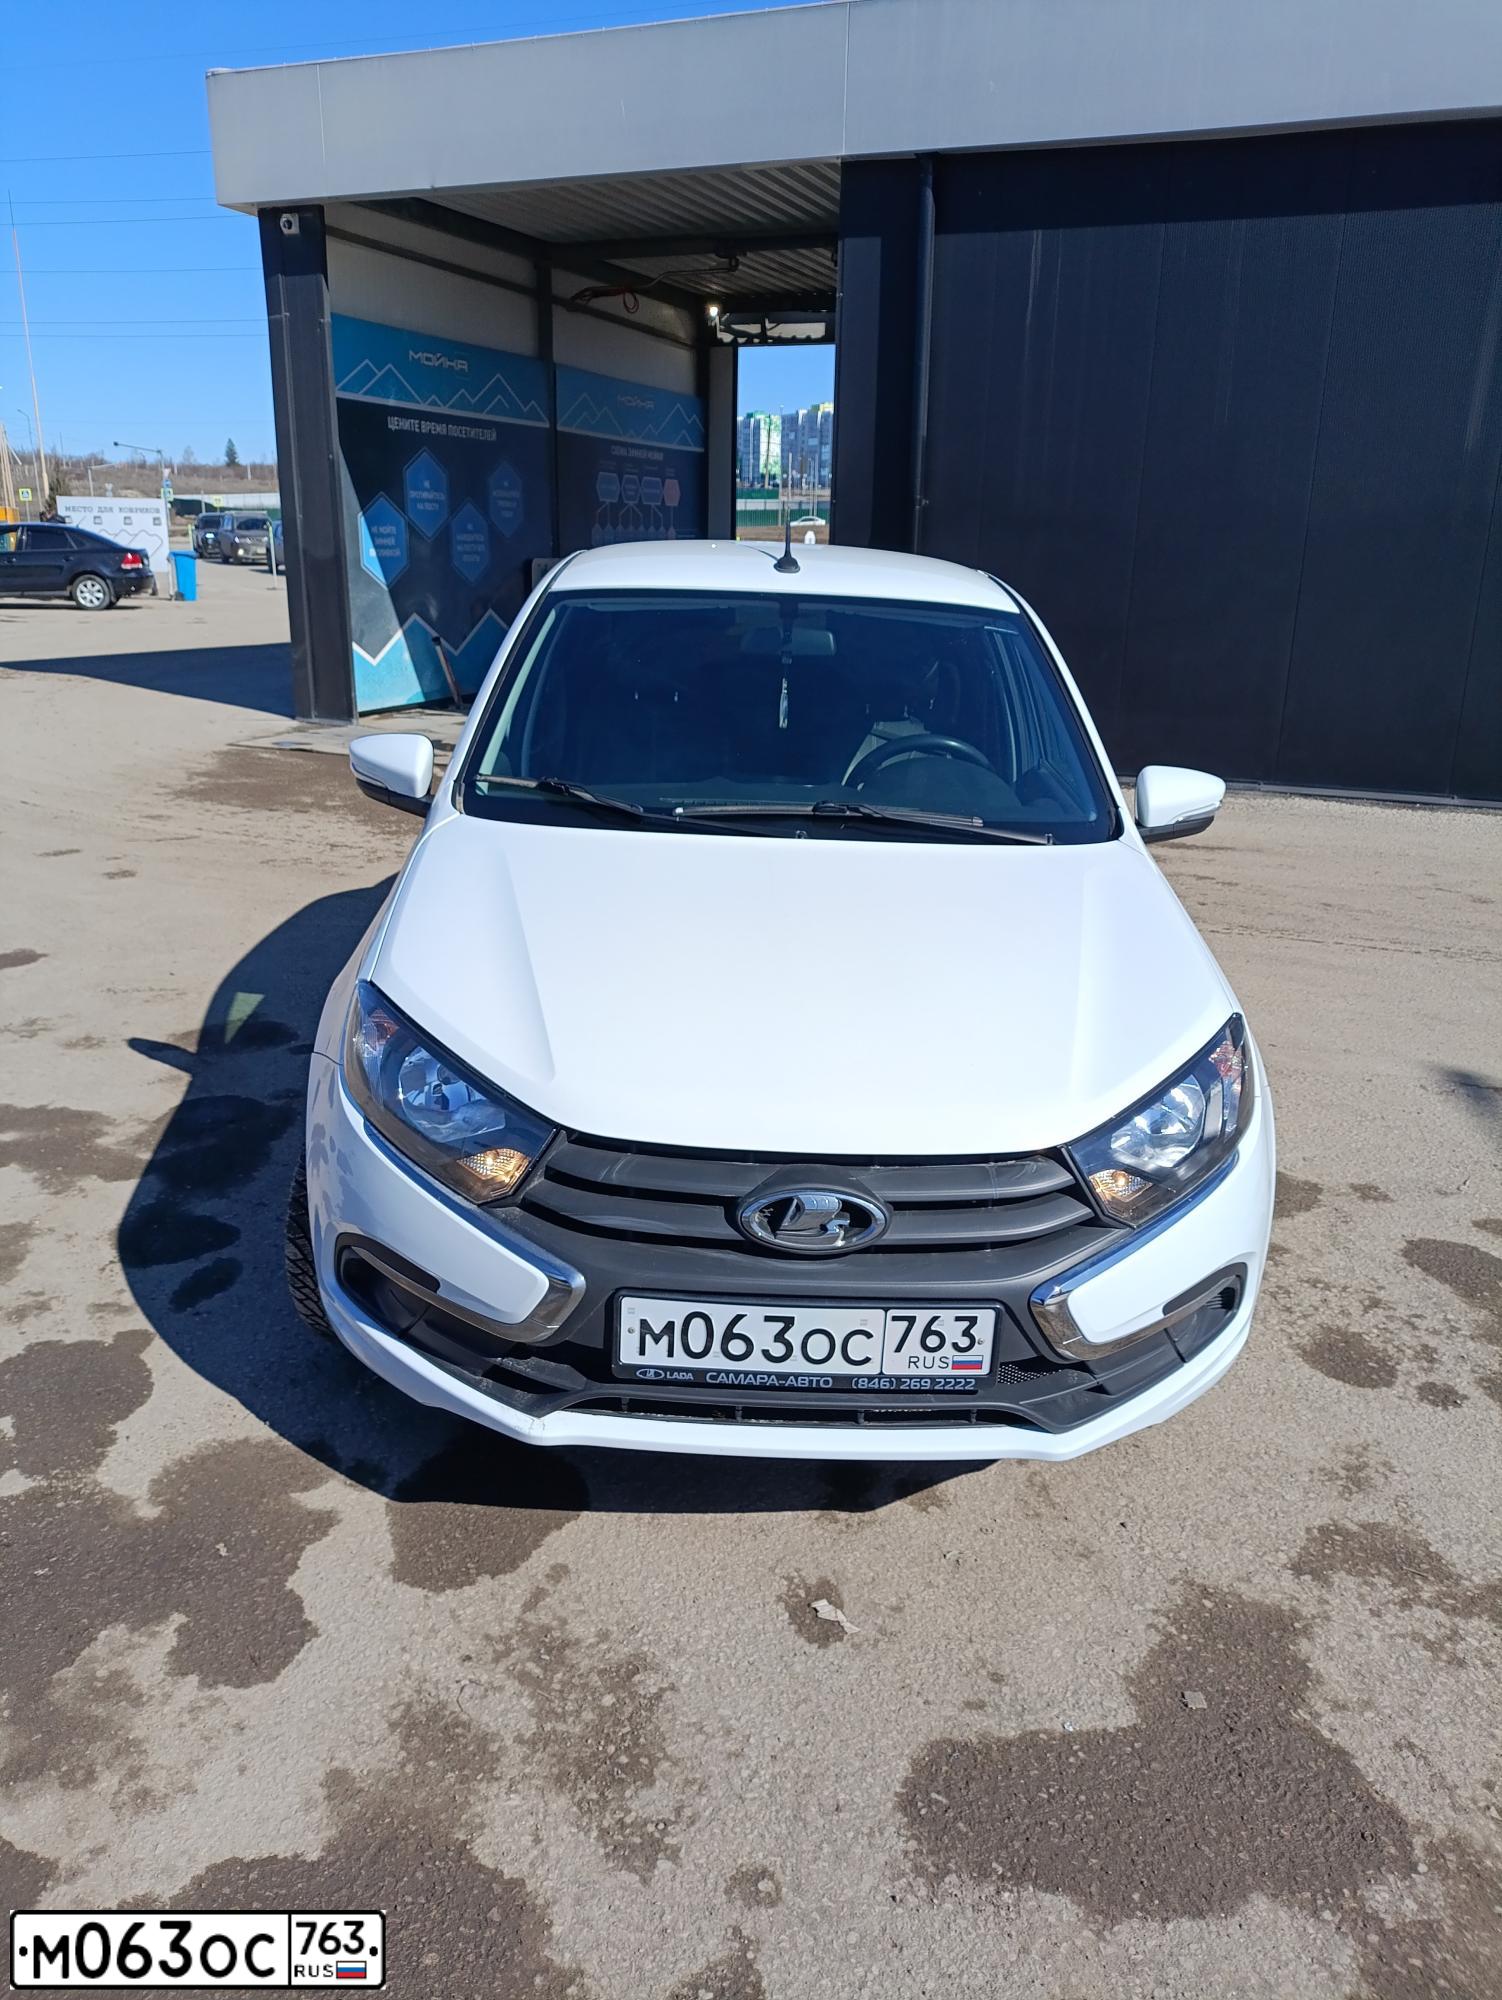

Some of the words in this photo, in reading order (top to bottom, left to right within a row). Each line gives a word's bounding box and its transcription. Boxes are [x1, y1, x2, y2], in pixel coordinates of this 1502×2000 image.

[387, 416, 420, 433] ЦЕНИТЕ
[420, 421, 447, 435] ВРЕМЯ
[448, 423, 497, 441] ПОСЕТИТЕЛЕЙ
[97, 506, 113, 514] ДЛЯ
[119, 506, 160, 514] КОВРИКОВ
[638, 1311, 874, 1367] М063ОС
[891, 1315, 979, 1354] 763
[907, 1355, 949, 1370] RUS
[666, 1371, 694, 1380] LADA
[706, 1372, 832, 1388] САМАРА-АВТО
[852, 1377, 896, 1389] (846)
[900, 1378, 931, 1390] 269
[933, 1378, 976, 1390] 2222
